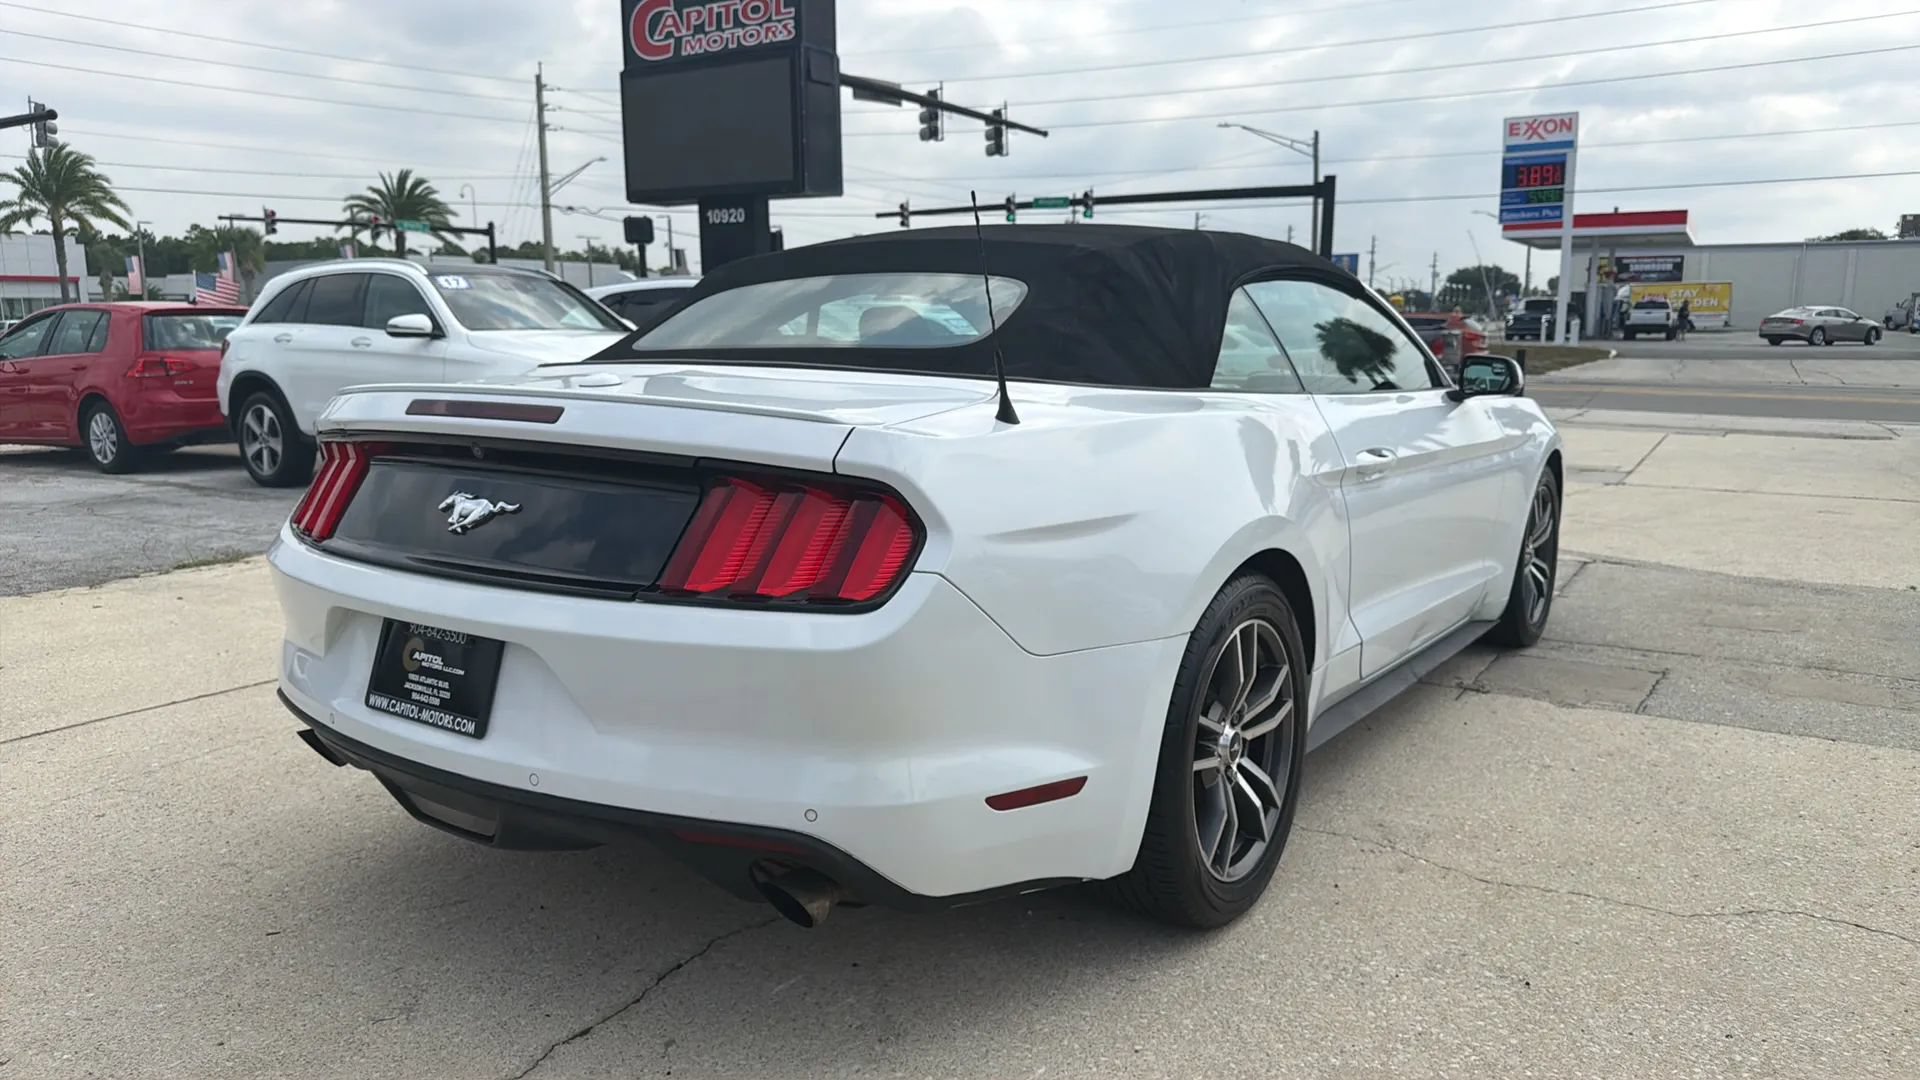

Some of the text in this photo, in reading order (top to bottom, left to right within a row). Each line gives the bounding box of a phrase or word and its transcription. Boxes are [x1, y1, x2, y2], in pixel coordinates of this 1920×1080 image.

[630, 0, 795, 60] CAPITOL
[681, 20, 795, 56] MOTORS
[1508, 118, 1573, 140] EXXON
[706, 208, 745, 224] 10920
[1671, 289, 1699, 298] STAY
[368, 693, 475, 735] WWW.CAPITOL-MOTORS.COM
